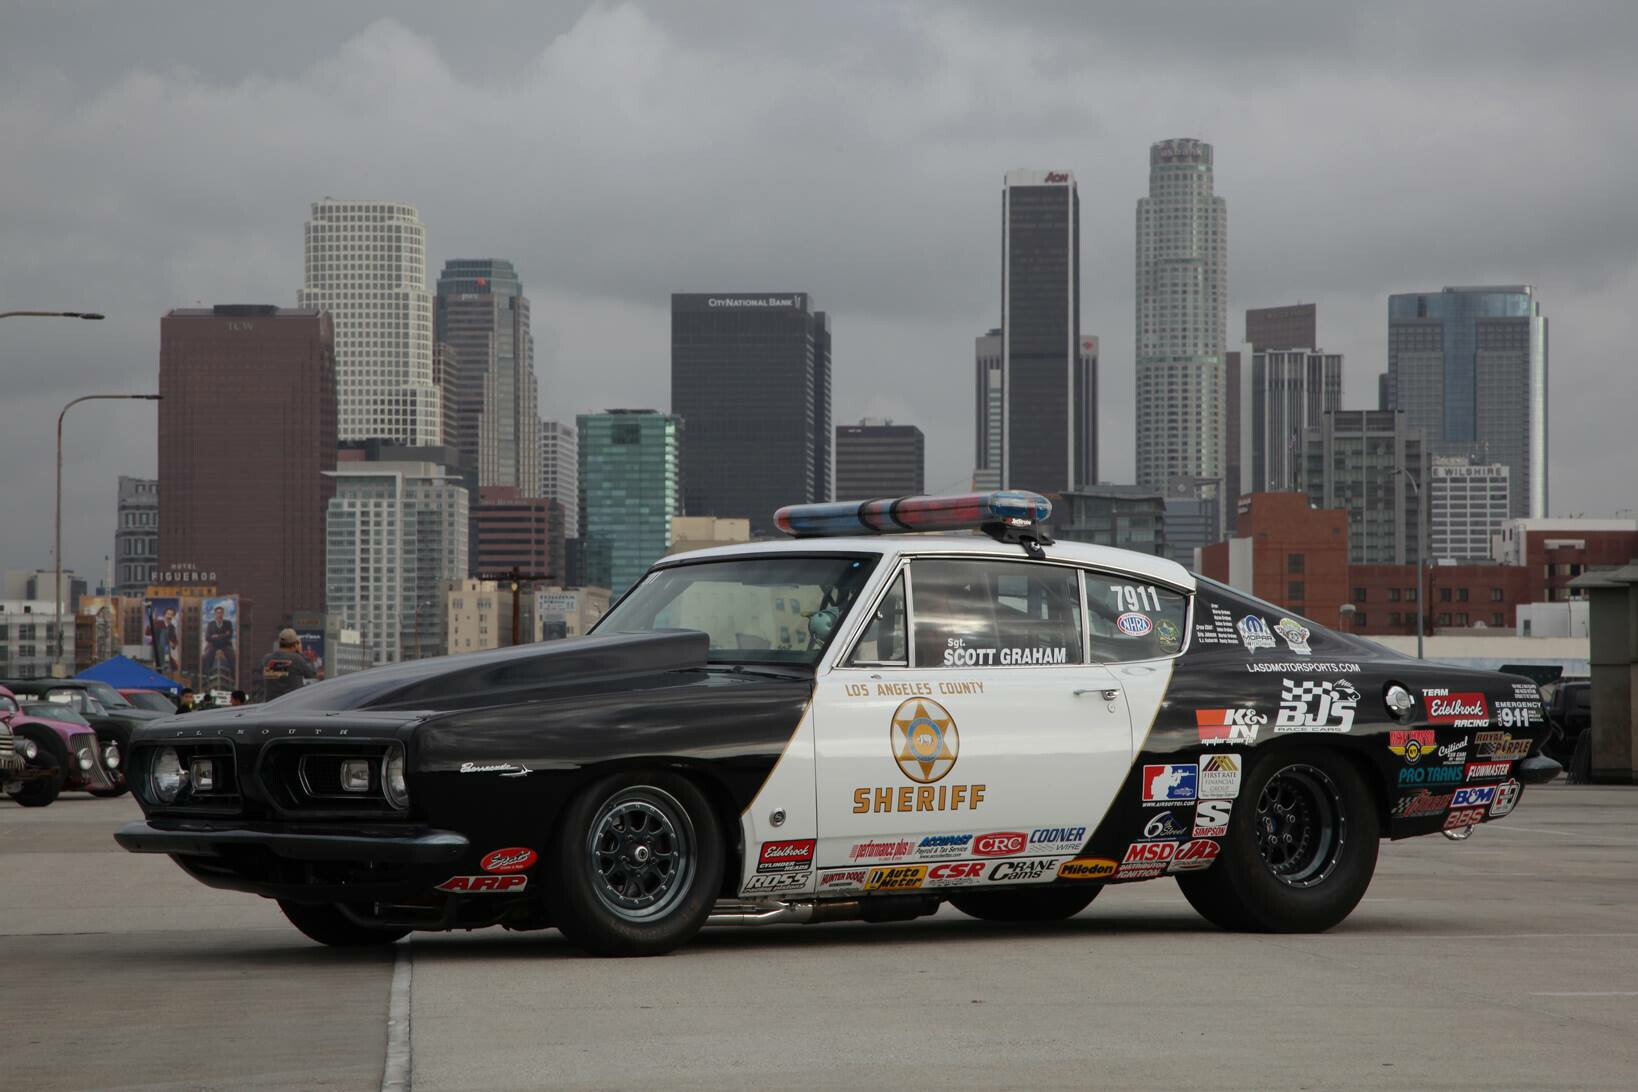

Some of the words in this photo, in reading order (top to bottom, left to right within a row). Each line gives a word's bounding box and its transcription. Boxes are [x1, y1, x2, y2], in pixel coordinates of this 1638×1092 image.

[1444, 466, 1503, 477] WILSHIRE
[151, 572, 217, 582] FIGUEROA
[1109, 585, 1163, 613] 7911
[1122, 616, 1149, 632] NHRA
[947, 638, 966, 650] Sgt.
[943, 648, 996, 667] SCOTT
[1000, 646, 1067, 665] GRAHAM
[1246, 663, 1361, 673] LASDMOTORSPORTS.COM
[844, 683, 870, 697] LOS
[877, 682, 933, 697] ANGELES
[939, 681, 985, 695] COUNTY
[1422, 688, 1449, 697] TEAM
[1274, 694, 1358, 731] BJS
[1430, 698, 1484, 717] Edelbrock
[1454, 718, 1490, 728] RACING
[176, 728, 349, 738] PLYMOUTH
[1475, 732, 1504, 743] ROYAL
[1397, 767, 1426, 784] PRO
[1427, 765, 1464, 783] TRANS
[1466, 763, 1511, 782] FLOWMASTER
[852, 784, 986, 814] SHERIFF
[1452, 788, 1496, 805] B&M
[1193, 826, 1226, 836] SIMPSON
[764, 844, 810, 858] Edelbrock
[979, 837, 1023, 853] CRC
[1056, 843, 1082, 851] WIRE
[1125, 843, 1176, 862] MSD
[758, 861, 796, 869] CYLINDER
[928, 861, 986, 880] CSR
[1060, 863, 1114, 876] Milodon
[744, 871, 814, 890] ROSS
[1116, 869, 1161, 879] IGNITION
[439, 876, 528, 891] ARP
